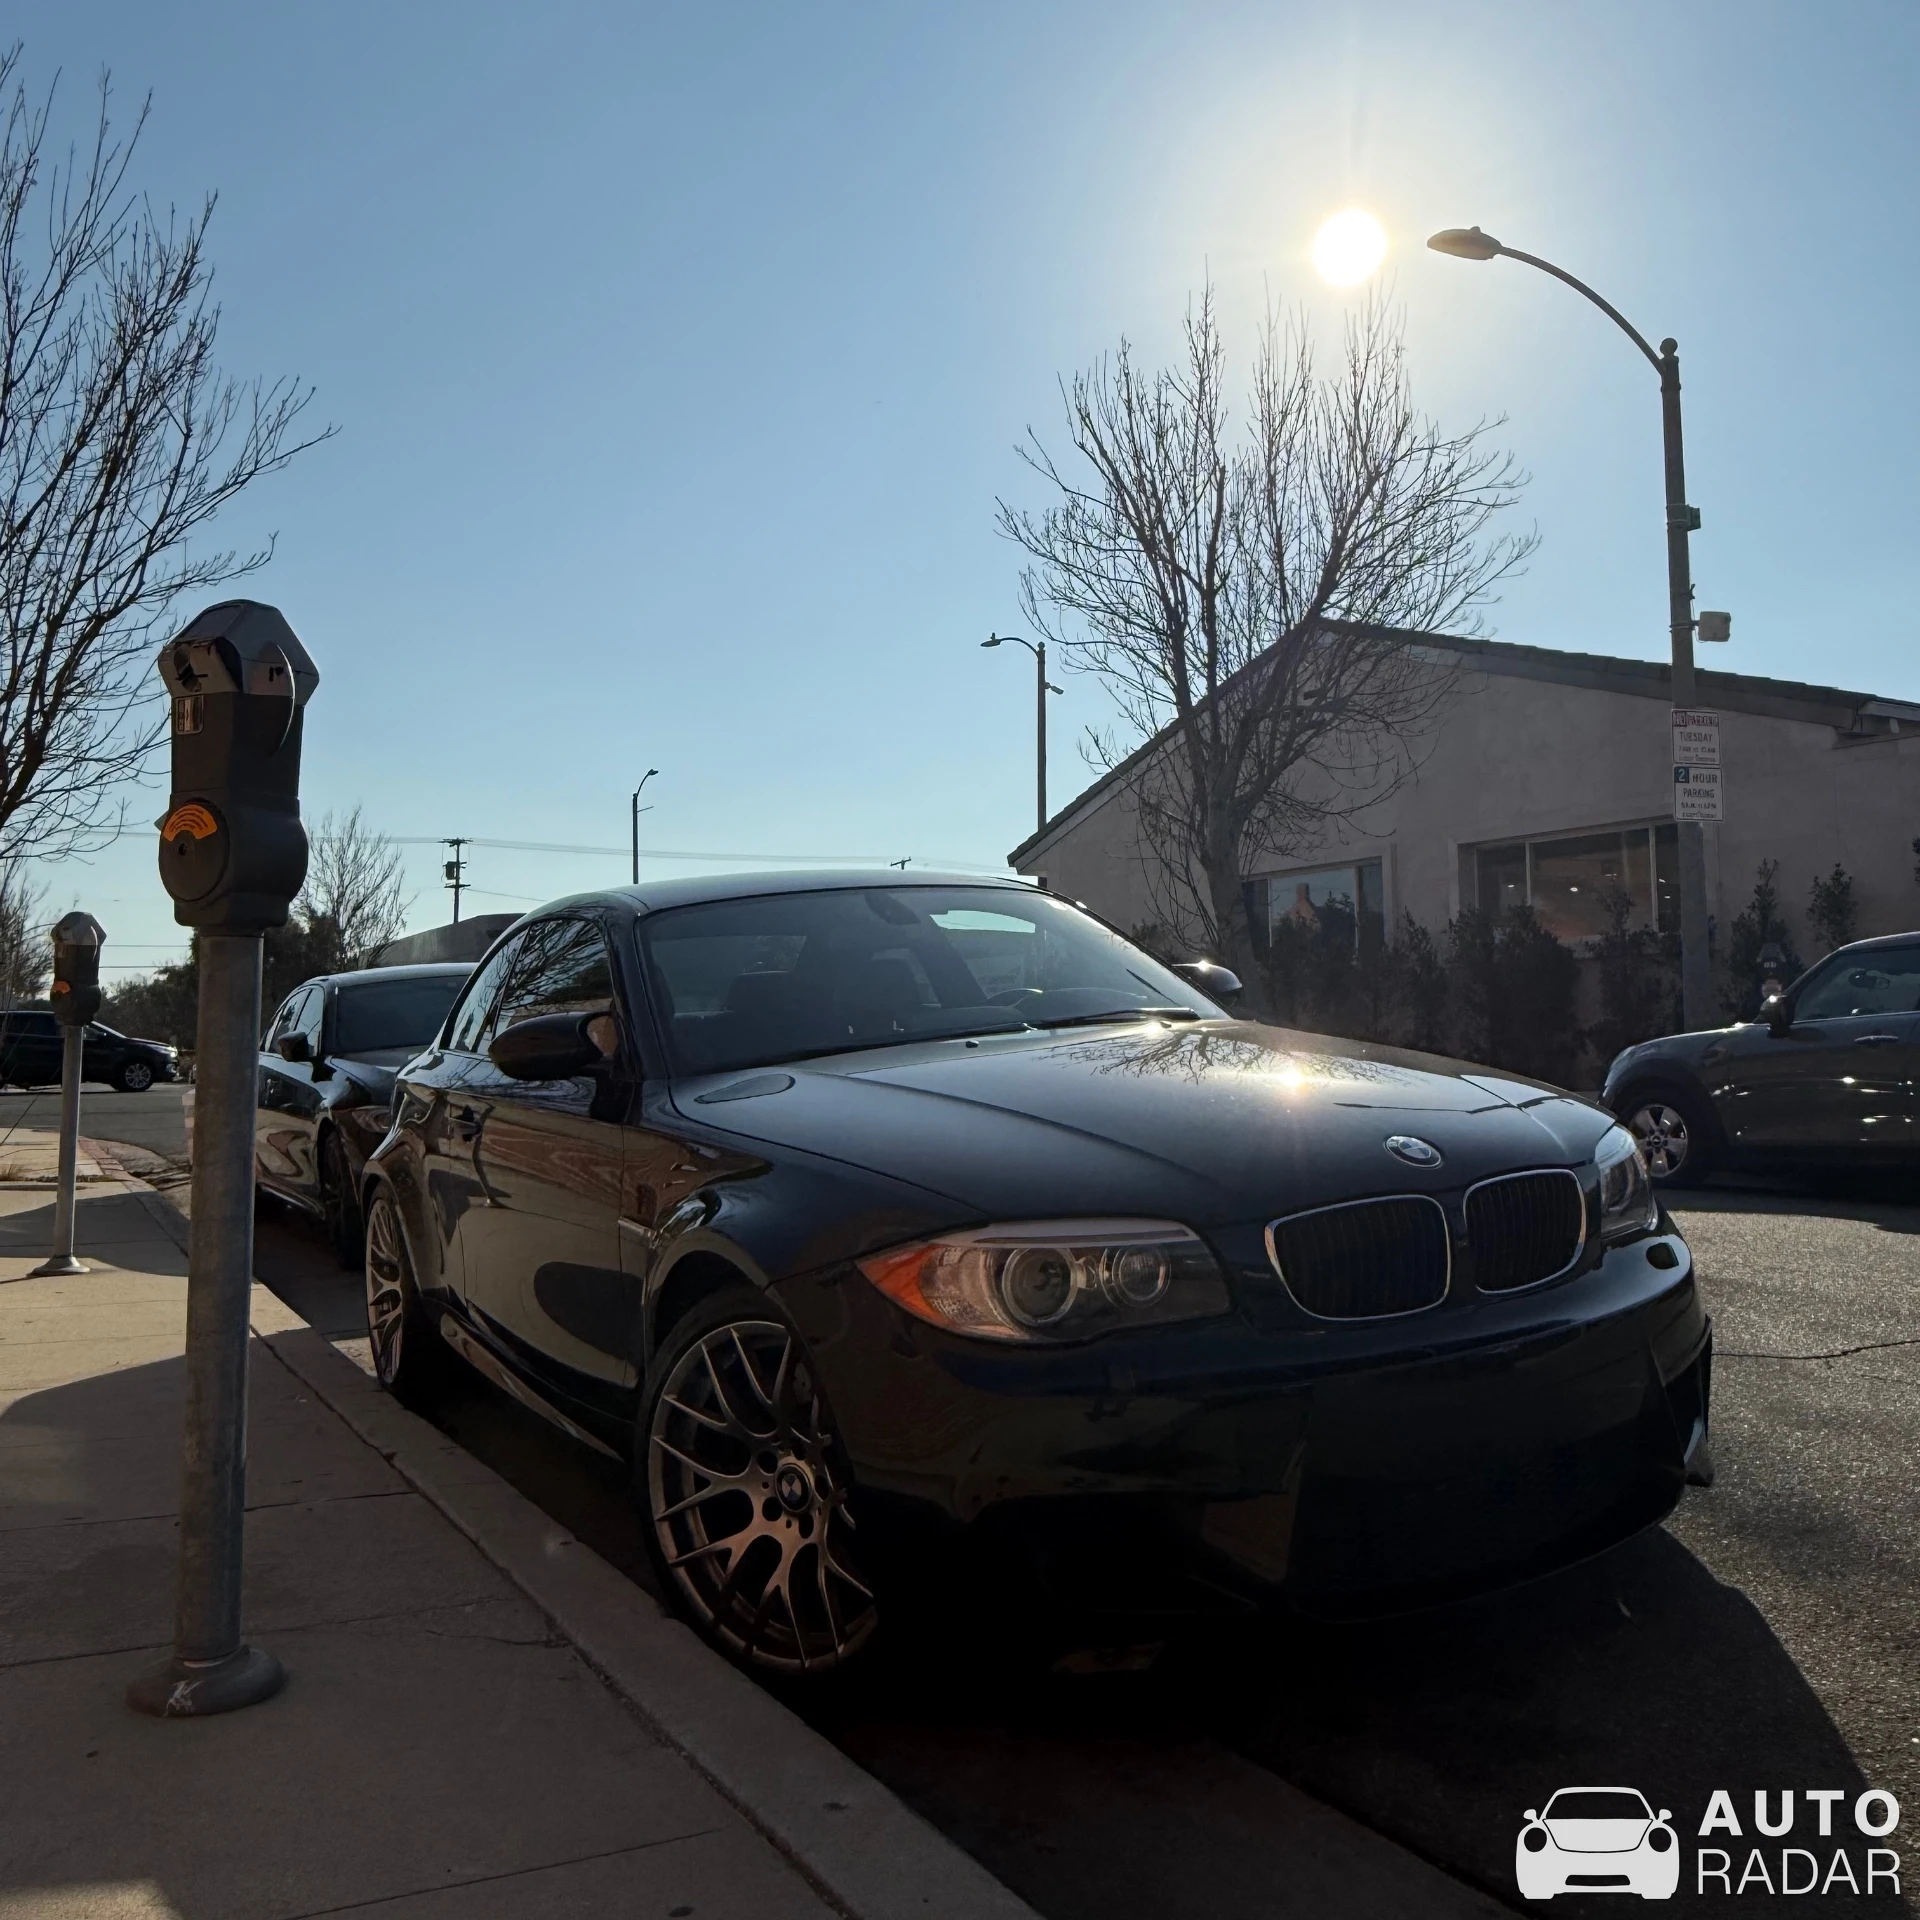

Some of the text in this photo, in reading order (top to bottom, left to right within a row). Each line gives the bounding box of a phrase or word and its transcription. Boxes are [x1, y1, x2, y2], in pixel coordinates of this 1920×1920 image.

[1679, 731, 1713, 742] TUESDAY
[1678, 767, 1718, 784] 2 HOUR
[1683, 787, 1715, 798] PARKING
